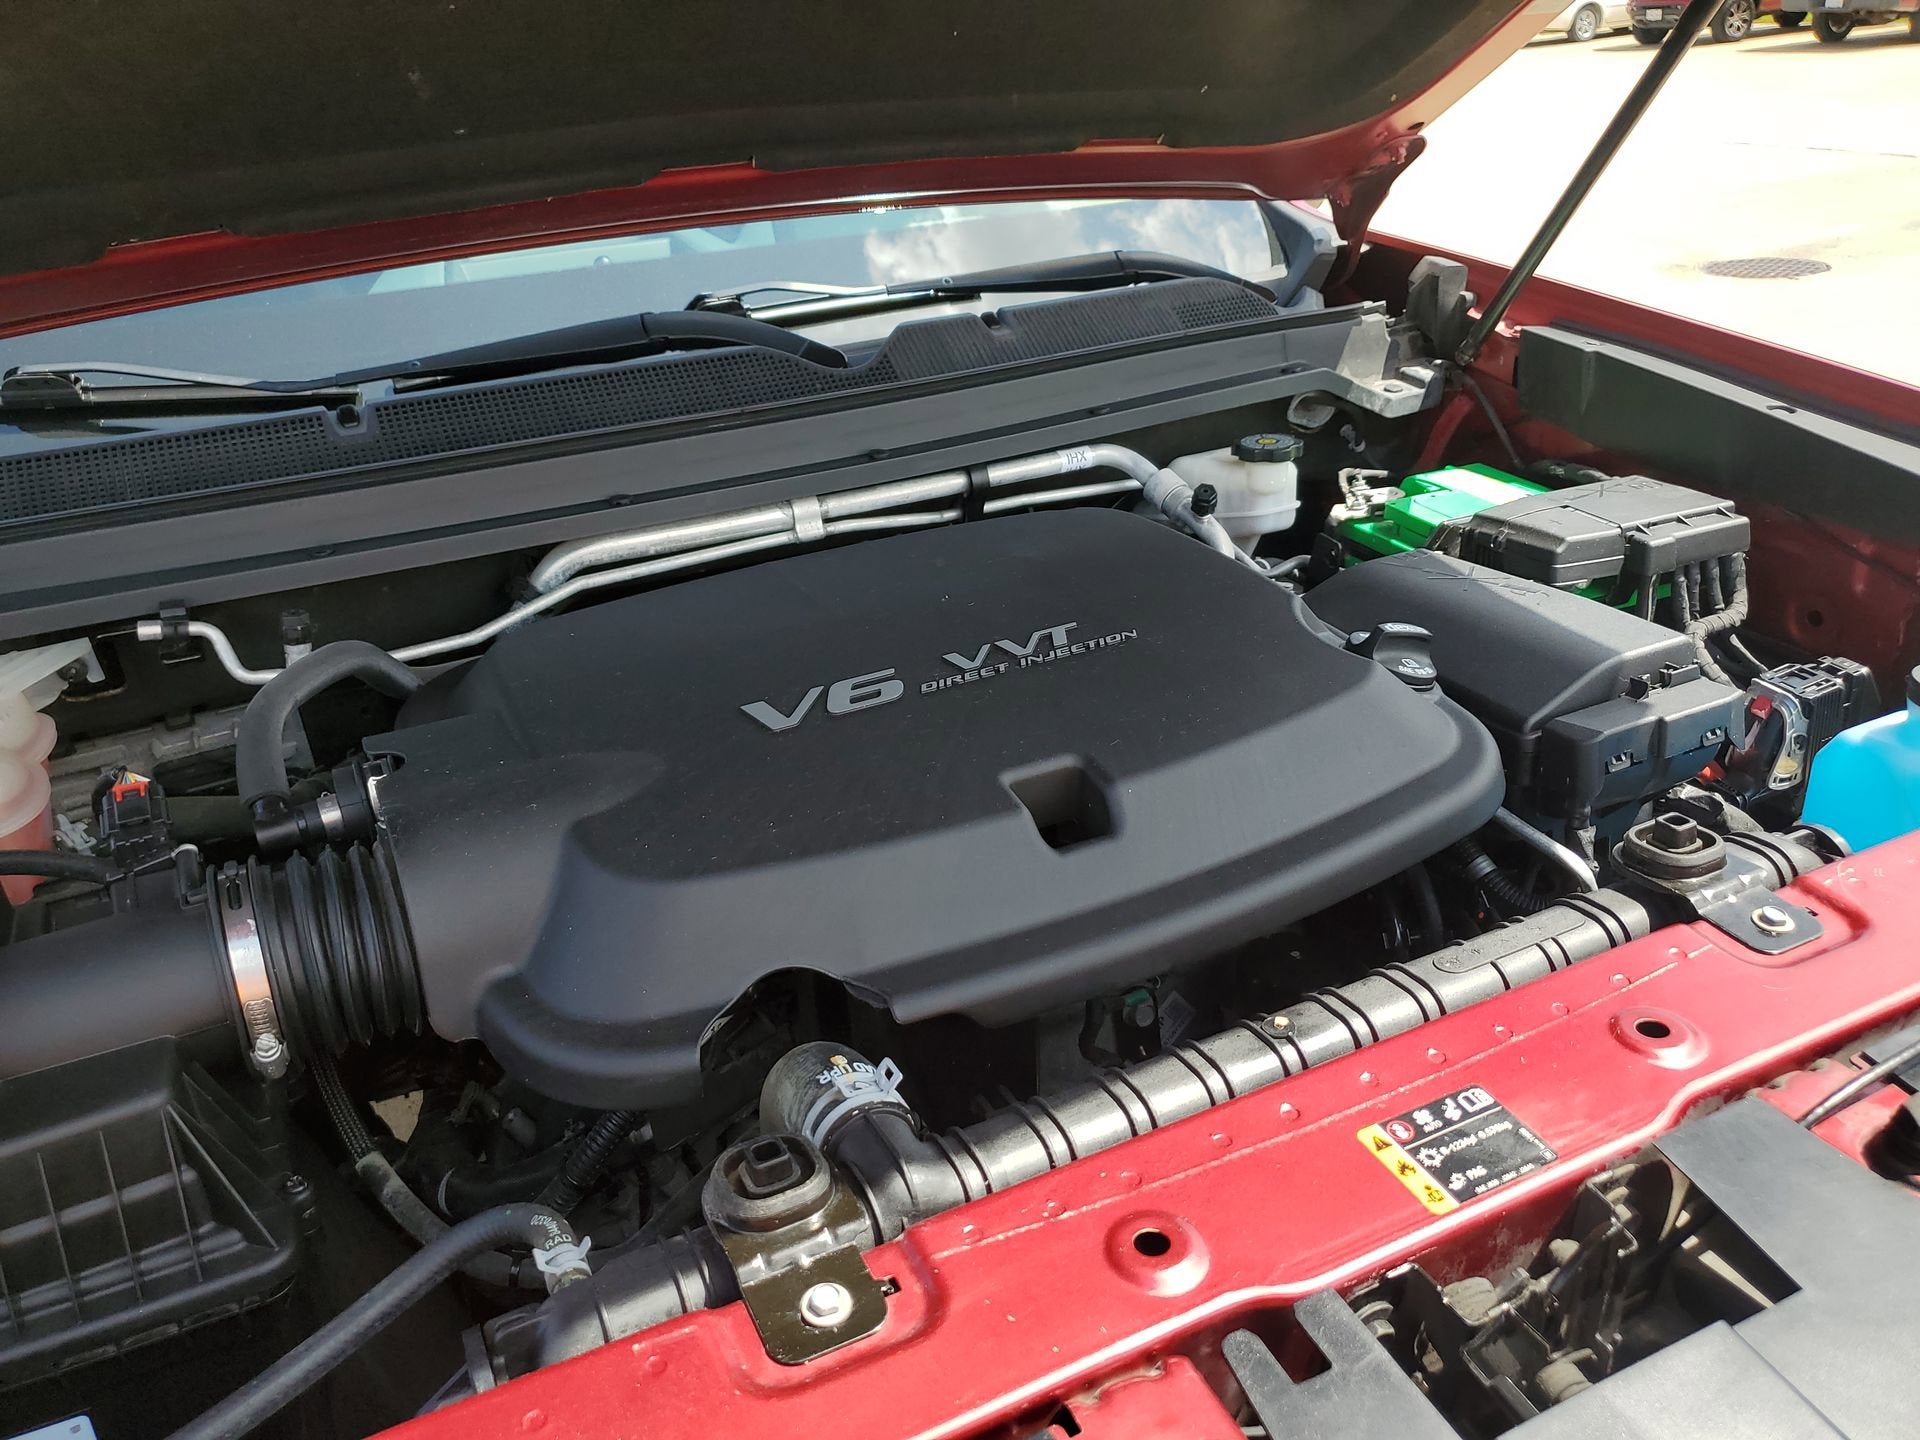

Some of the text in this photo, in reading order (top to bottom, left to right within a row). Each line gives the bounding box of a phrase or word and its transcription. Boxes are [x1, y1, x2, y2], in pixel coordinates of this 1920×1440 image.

[920, 628, 1138, 694] DIRECT INJECTION
[941, 621, 1078, 671] VVT
[739, 667, 905, 732] V6
[1423, 1119, 1443, 1134] AUTO
[544, 1233, 573, 1250] RAD
